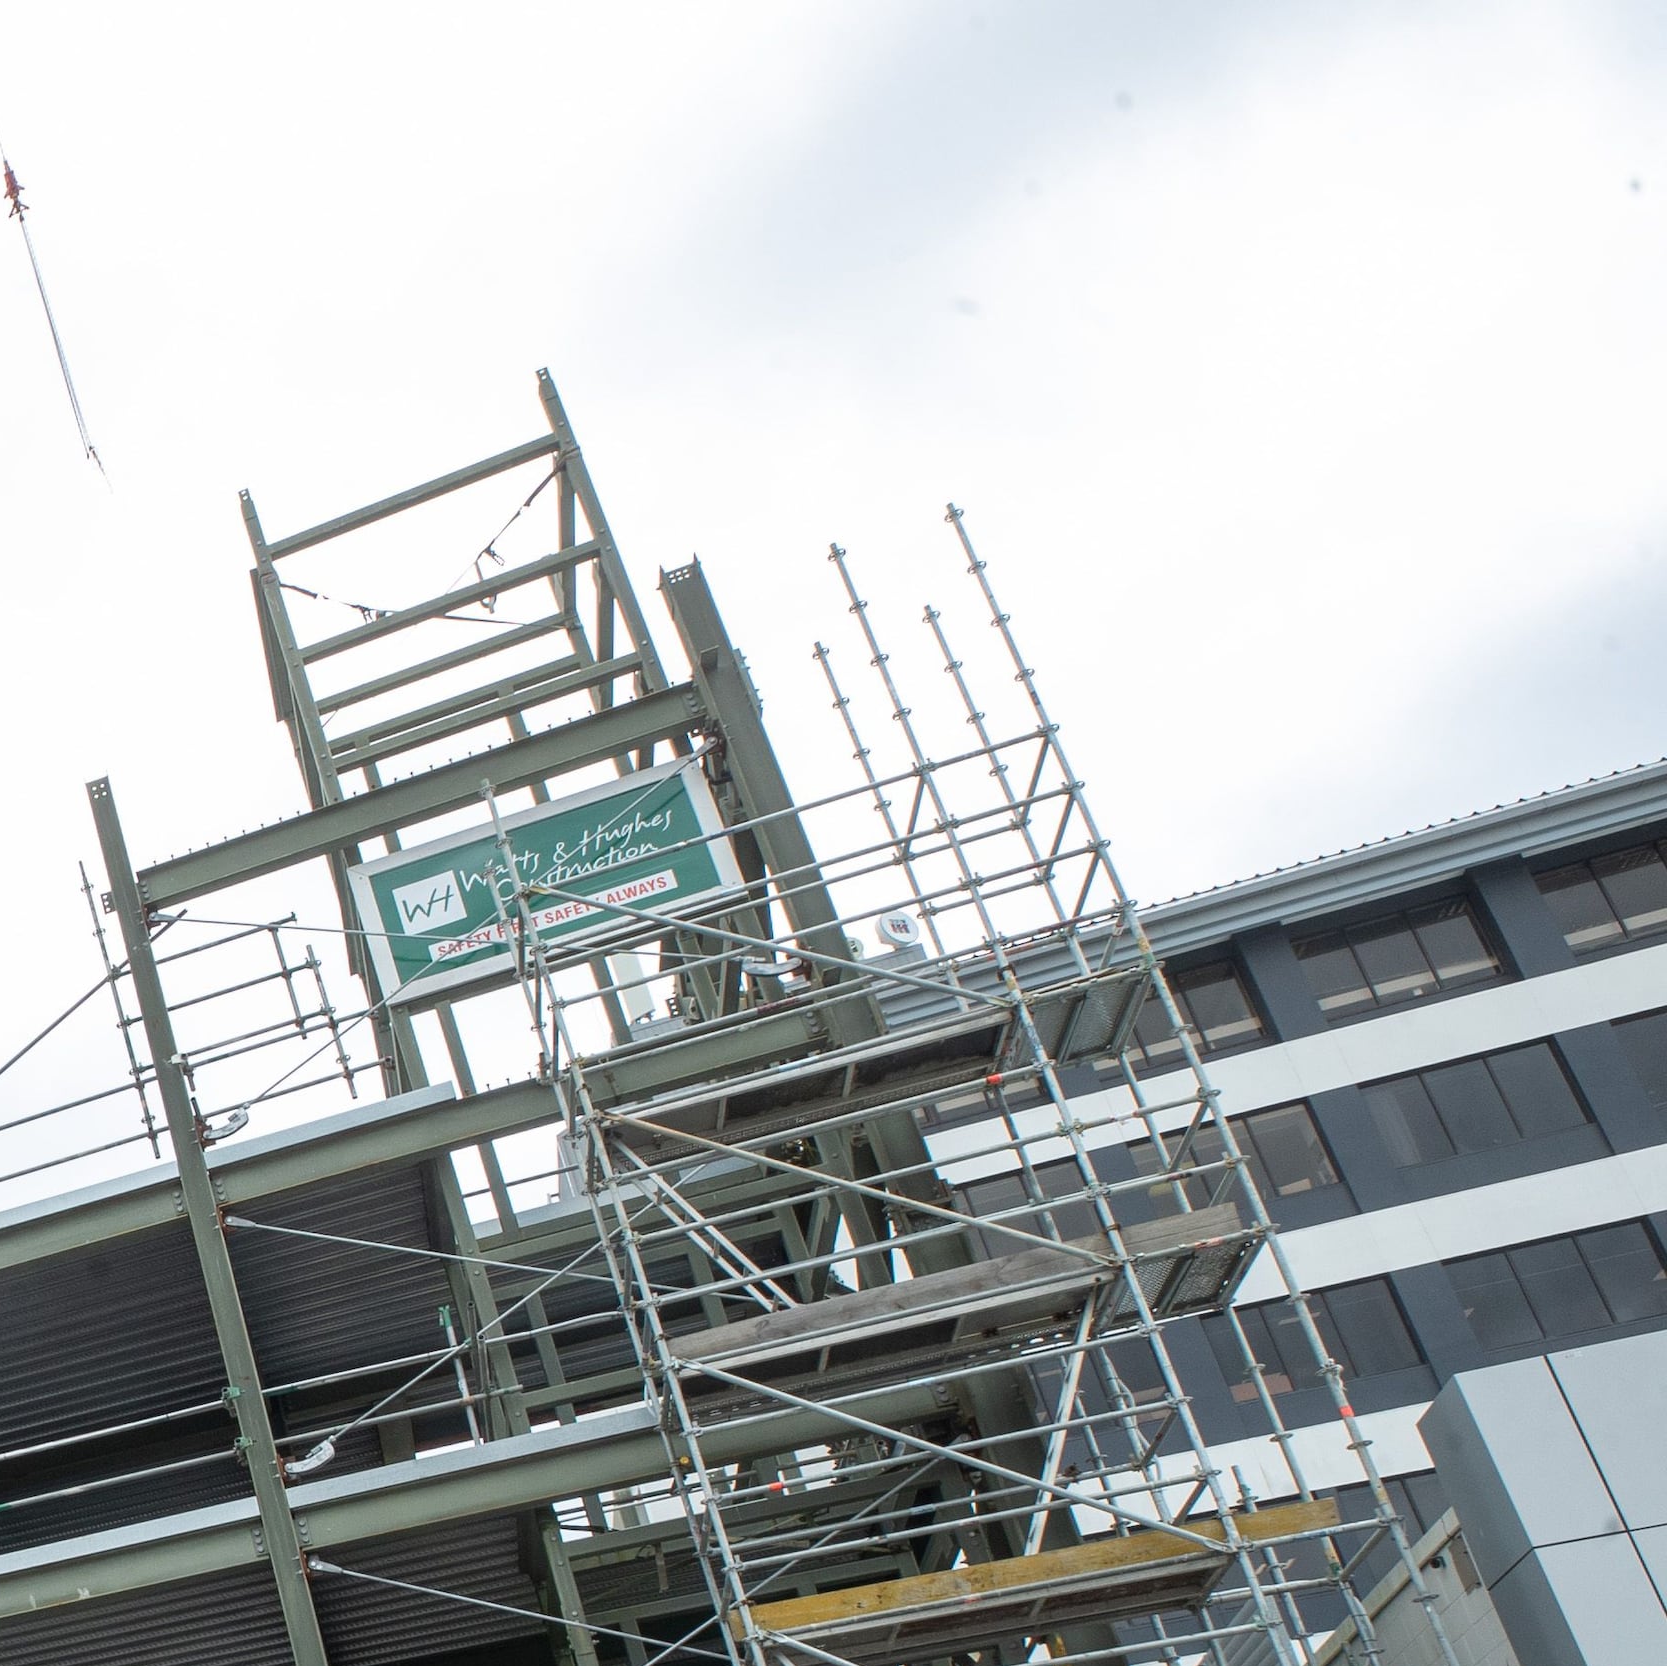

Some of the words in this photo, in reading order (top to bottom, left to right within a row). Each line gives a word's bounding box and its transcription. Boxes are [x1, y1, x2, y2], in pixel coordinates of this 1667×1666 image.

[554, 842, 569, 864] &
[580, 809, 672, 857] Hughes
[403, 884, 455, 923] WH
[605, 876, 668, 905] ALWAYS
